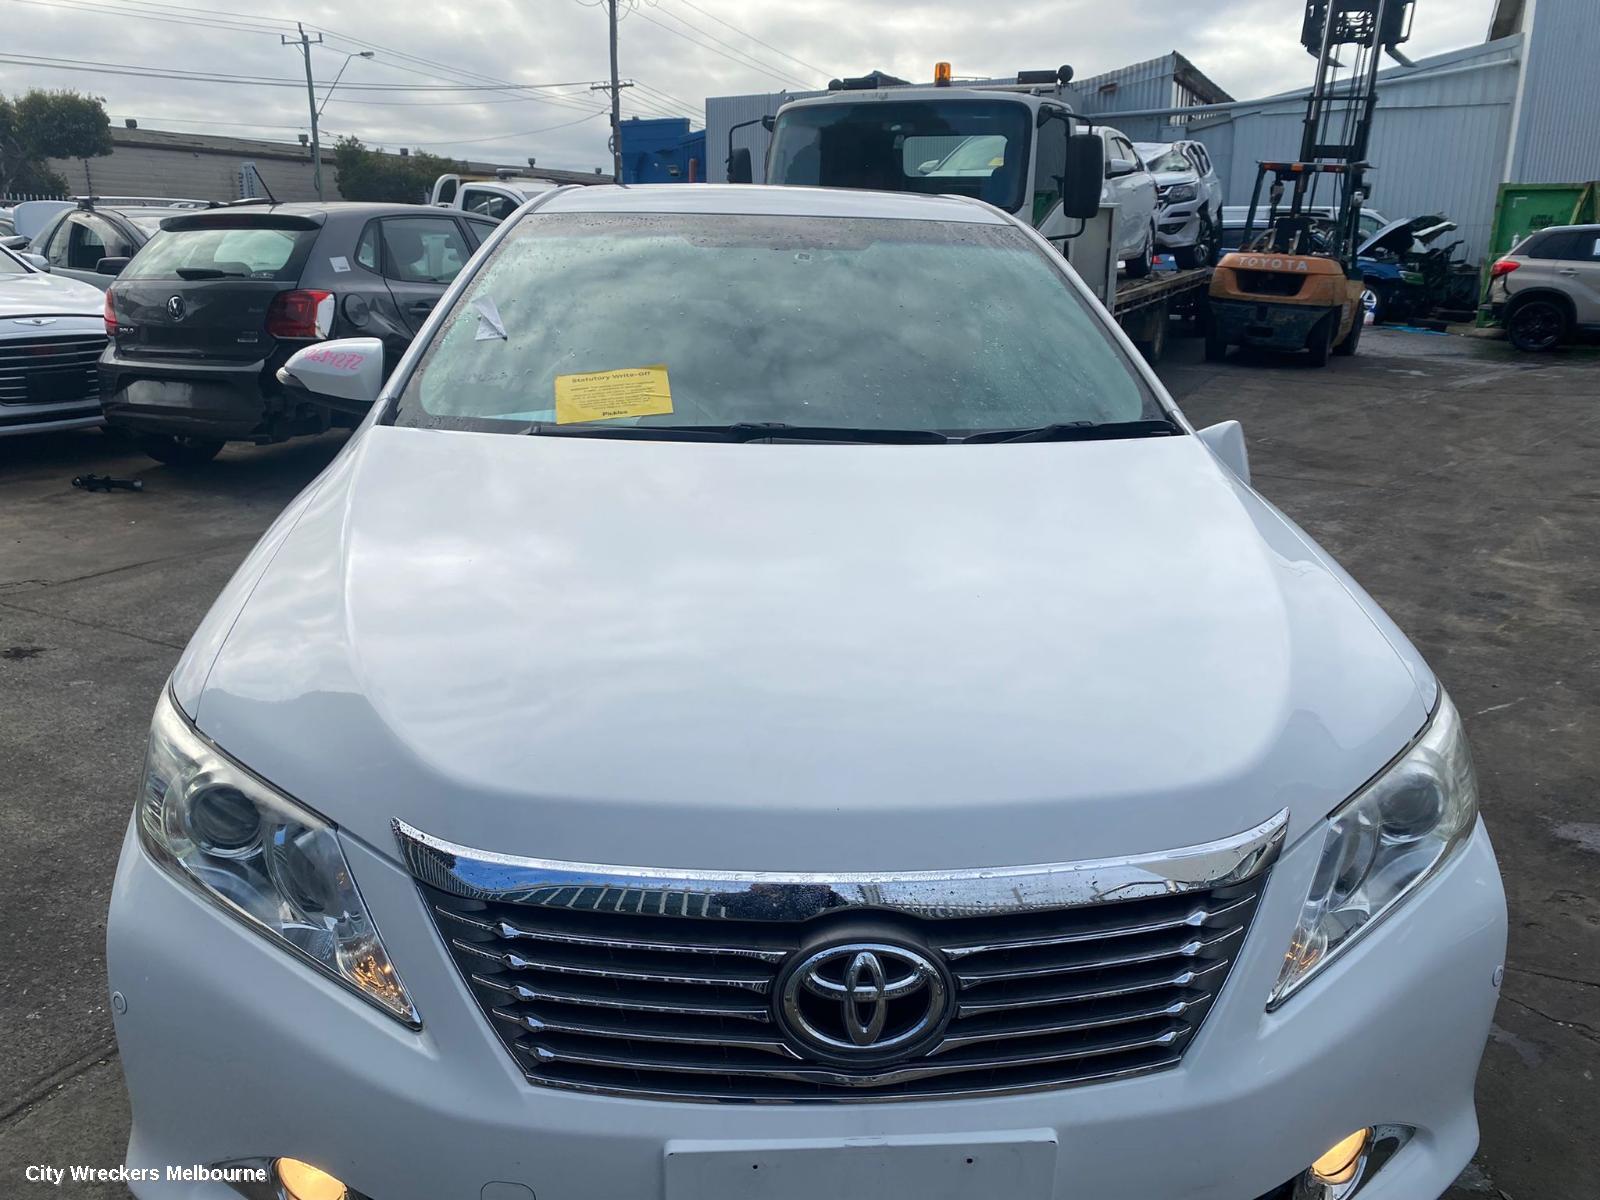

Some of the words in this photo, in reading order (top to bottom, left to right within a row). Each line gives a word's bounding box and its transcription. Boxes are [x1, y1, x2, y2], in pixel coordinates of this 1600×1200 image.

[1240, 256, 1309, 271] TOYOTA
[571, 374, 610, 383] Statutory
[612, 371, 651, 380] Write-Off
